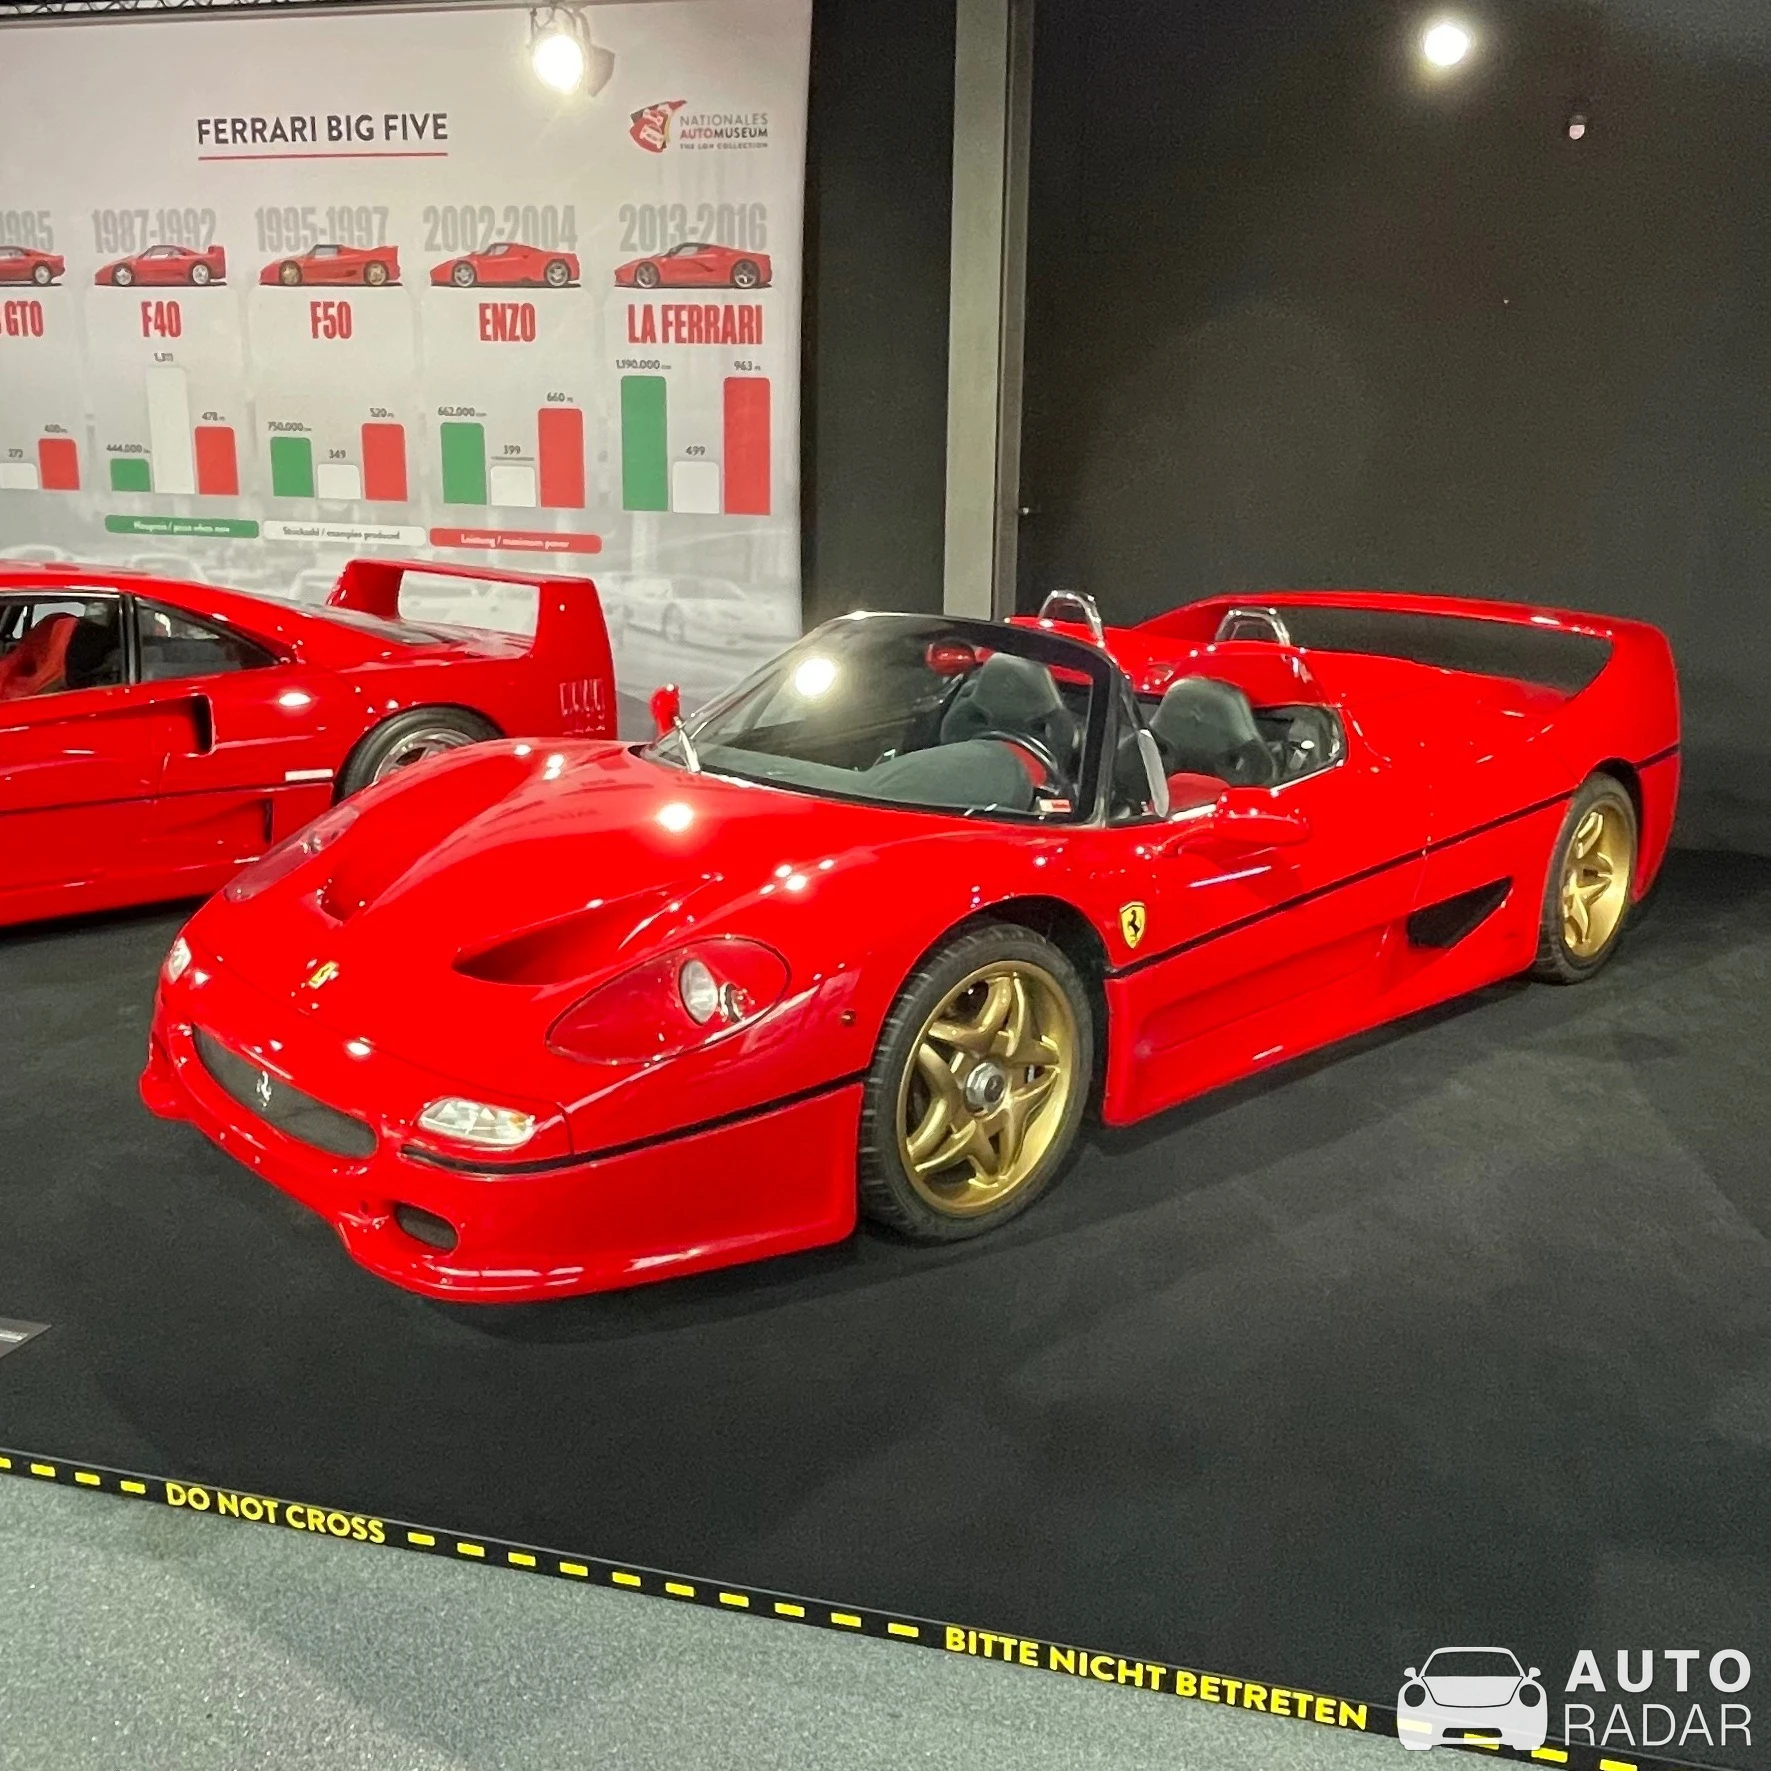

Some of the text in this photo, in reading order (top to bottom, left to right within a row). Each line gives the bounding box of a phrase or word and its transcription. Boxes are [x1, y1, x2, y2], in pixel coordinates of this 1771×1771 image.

[197, 112, 449, 145] FERRARI BIG FIVE
[679, 113, 769, 127] NATIONALES
[679, 127, 768, 140] AUTOMUSEUM
[618, 203, 767, 252] 2013-2016
[4, 300, 44, 337] GTO
[141, 301, 182, 338] F40
[310, 301, 352, 339] F50
[478, 303, 536, 342] ENZO
[627, 304, 763, 344] LA FERRARI
[165, 1481, 387, 1545] DO NOT CROSS
[944, 1625, 1369, 1731] BITTE NICHT BETRETEN
